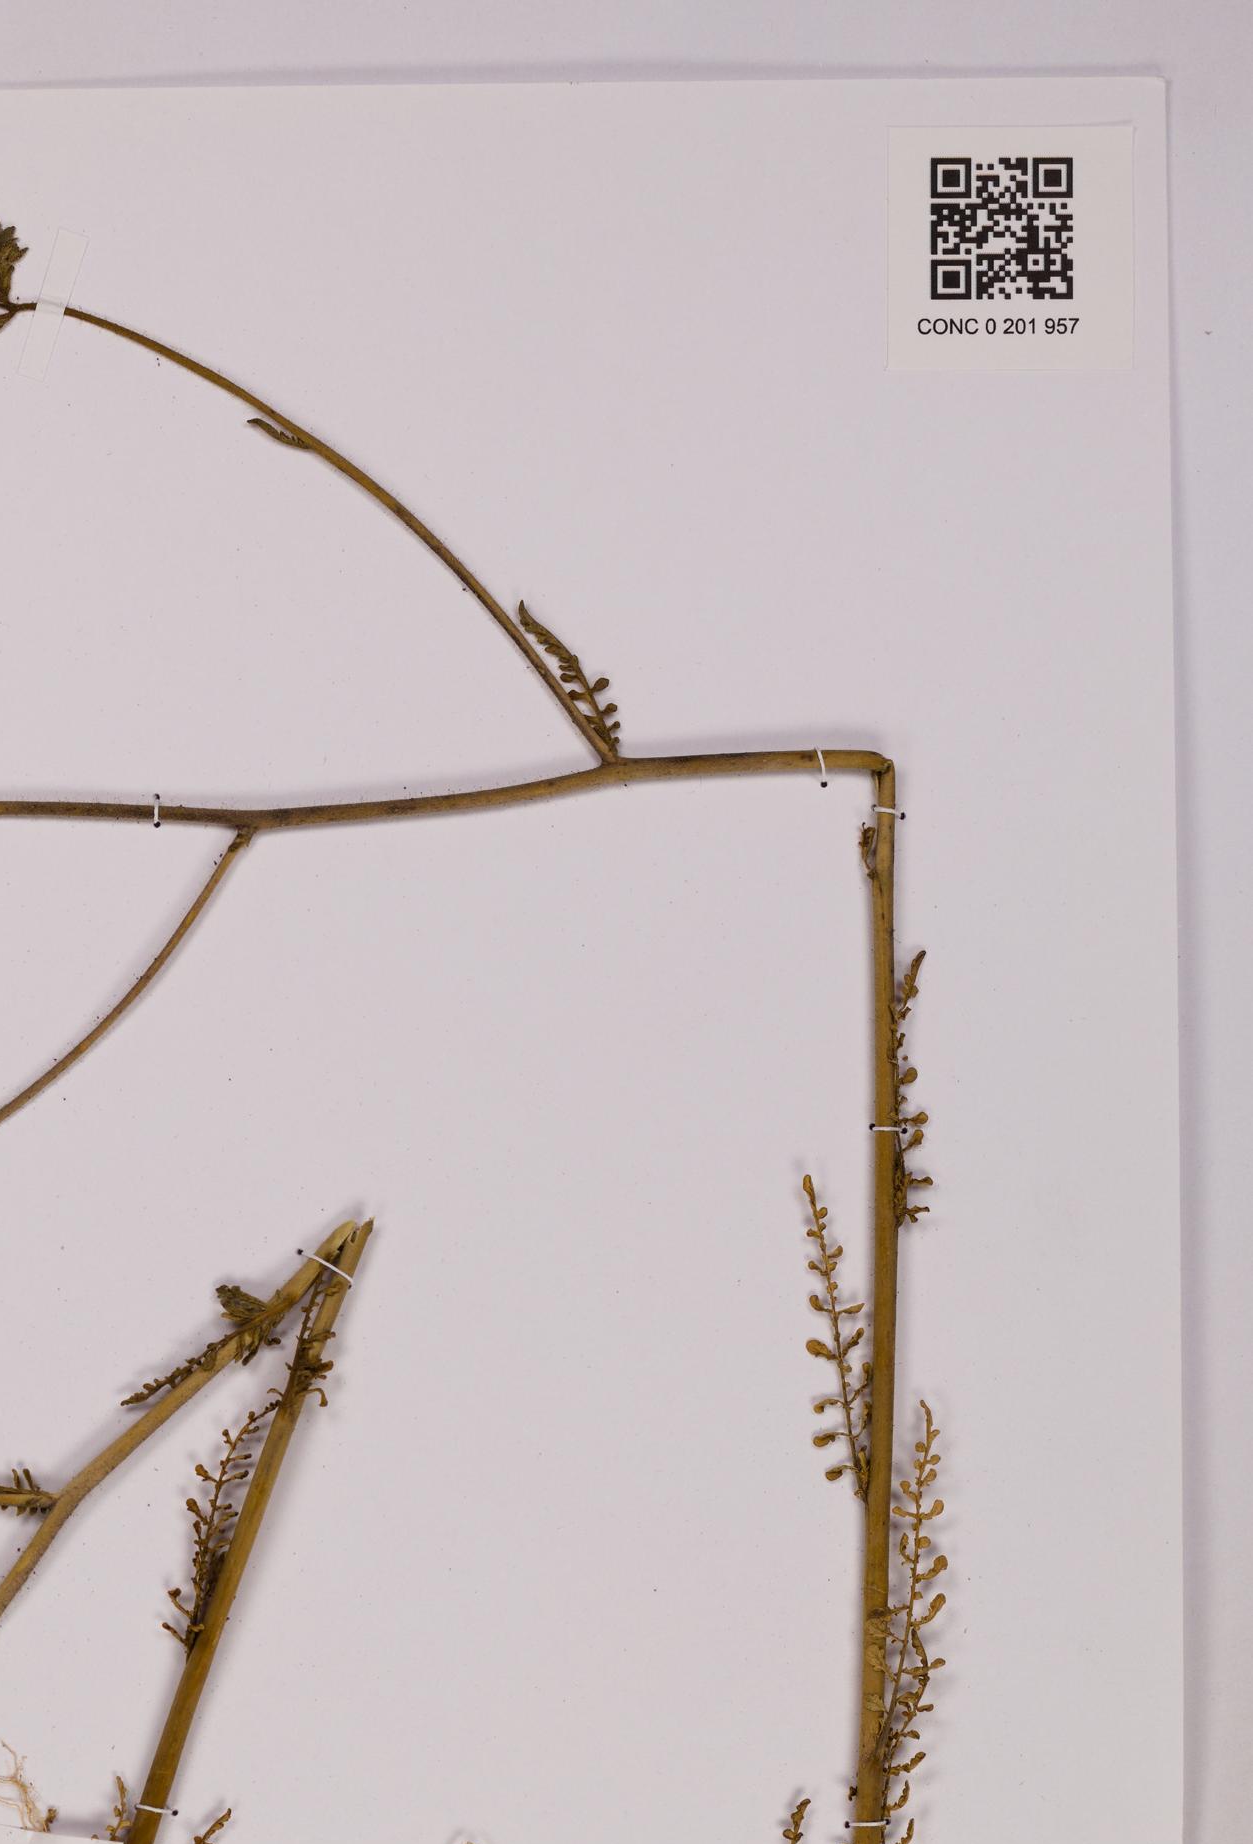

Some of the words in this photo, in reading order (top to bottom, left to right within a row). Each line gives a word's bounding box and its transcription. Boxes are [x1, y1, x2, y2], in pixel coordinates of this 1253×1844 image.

[917, 318, 979, 336] CONC
[985, 317, 997, 335] 0
[1002, 317, 1036, 335] 201
[1044, 317, 1080, 335] 957
